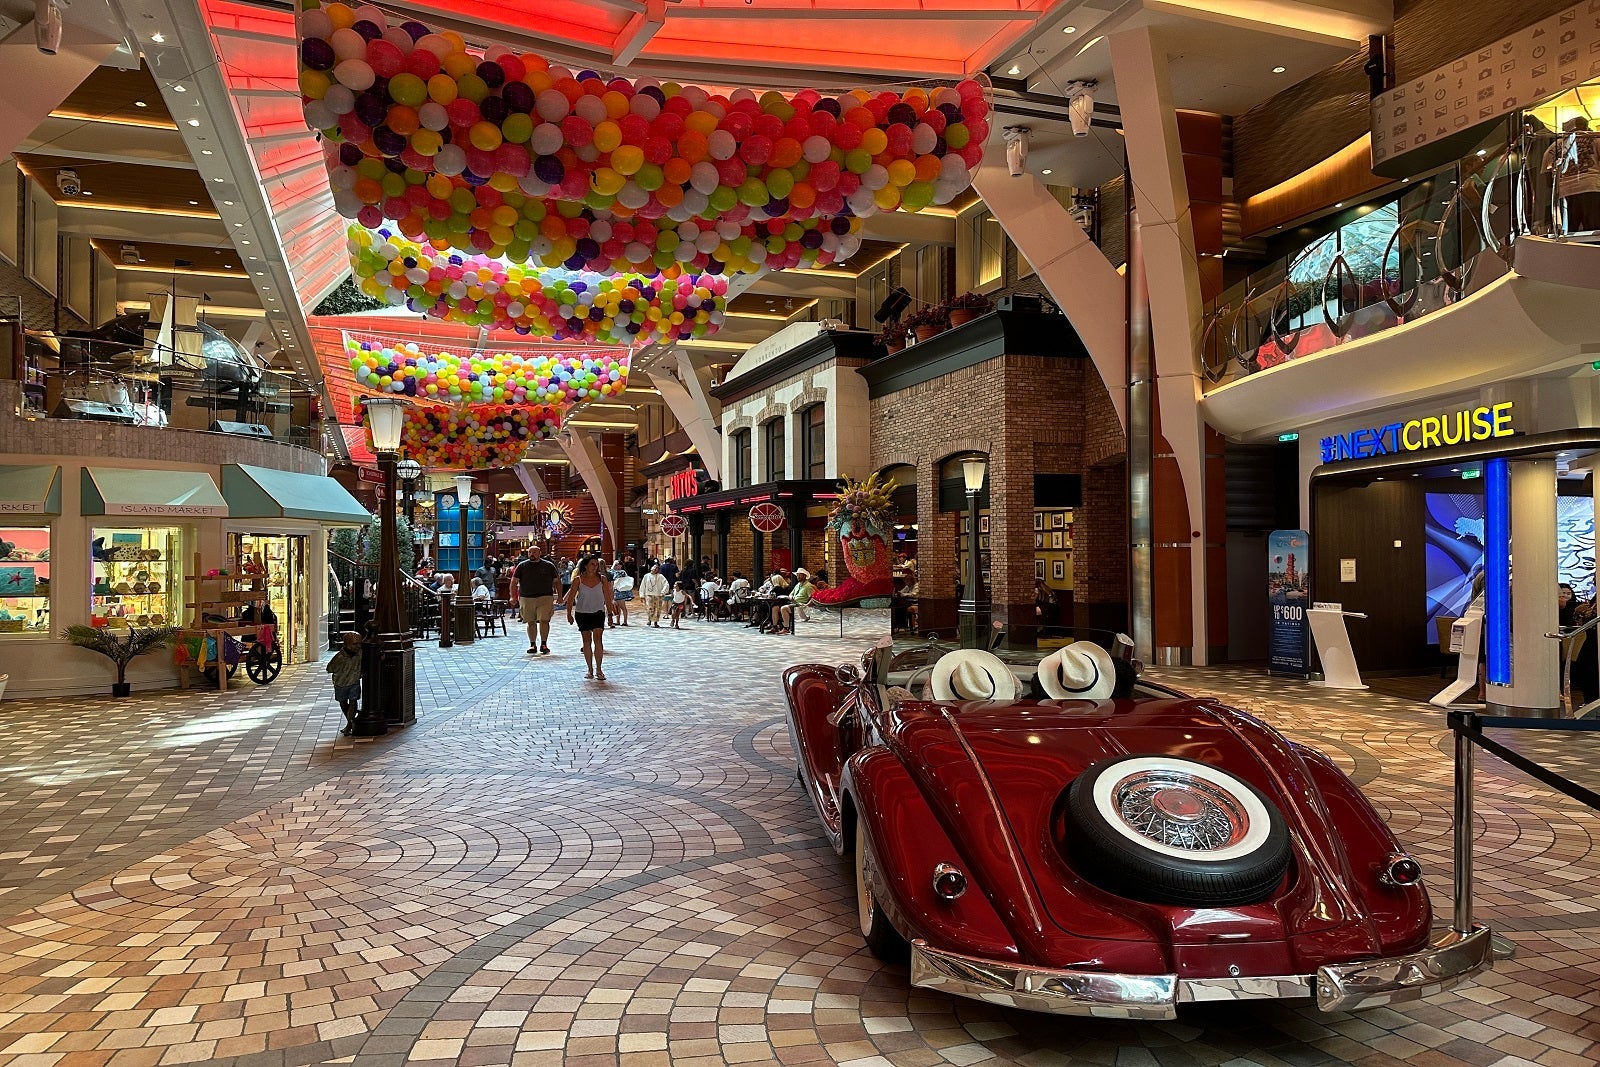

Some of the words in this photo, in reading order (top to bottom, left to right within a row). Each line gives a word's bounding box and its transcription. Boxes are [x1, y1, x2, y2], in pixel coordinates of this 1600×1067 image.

[120, 505, 165, 514] ISLAND
[168, 506, 215, 515] MARKET
[1281, 606, 1302, 620] $600
